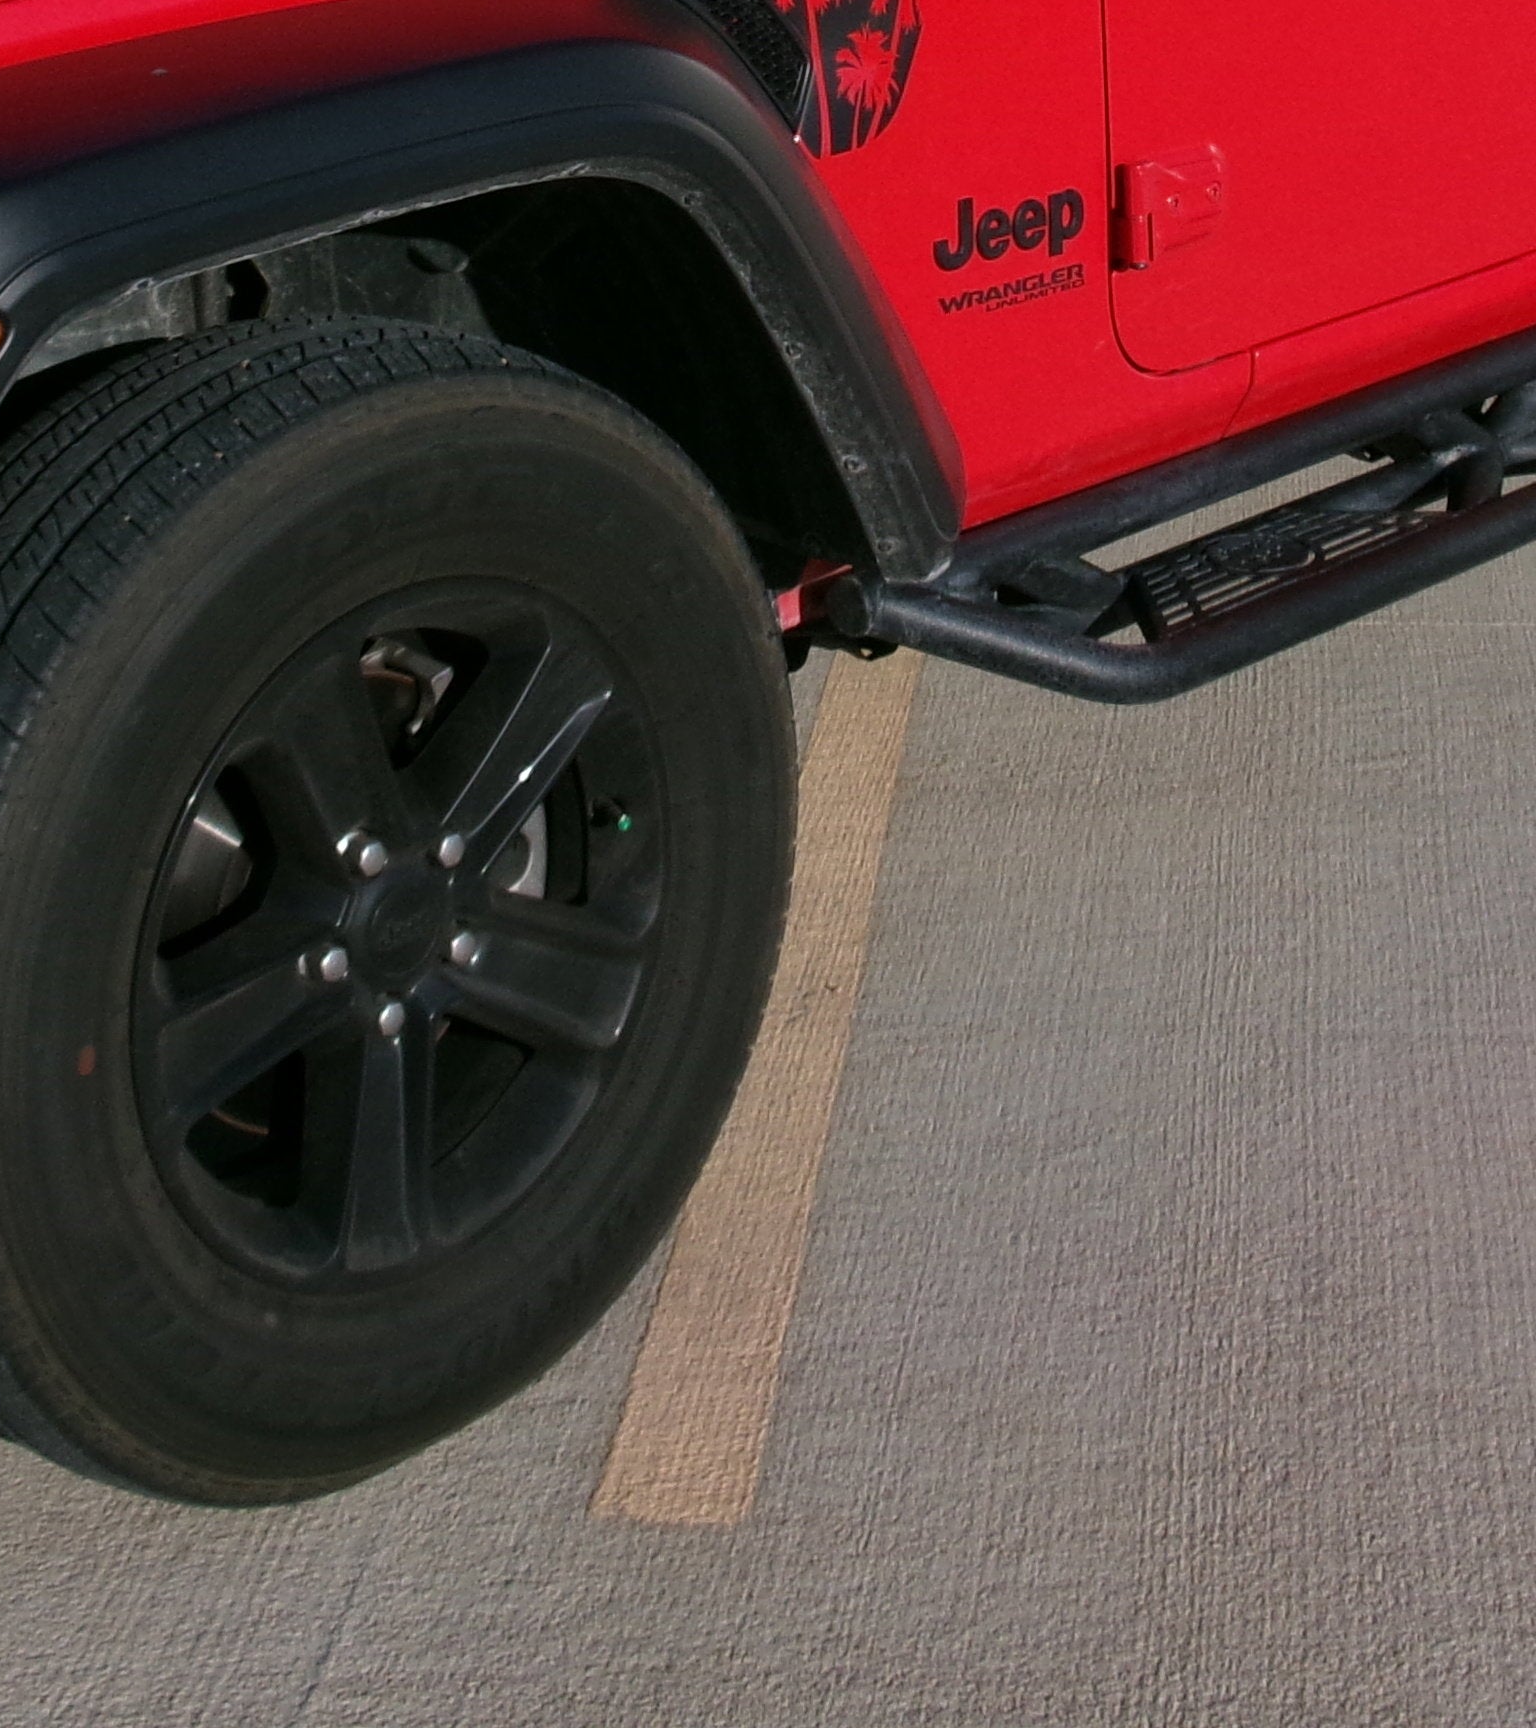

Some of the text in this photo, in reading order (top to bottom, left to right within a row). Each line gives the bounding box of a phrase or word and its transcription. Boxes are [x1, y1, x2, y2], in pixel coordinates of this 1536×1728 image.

[933, 188, 1084, 272] Jeep
[938, 263, 1084, 315] WRANGLER
[985, 278, 1085, 313] UNLIMITED
